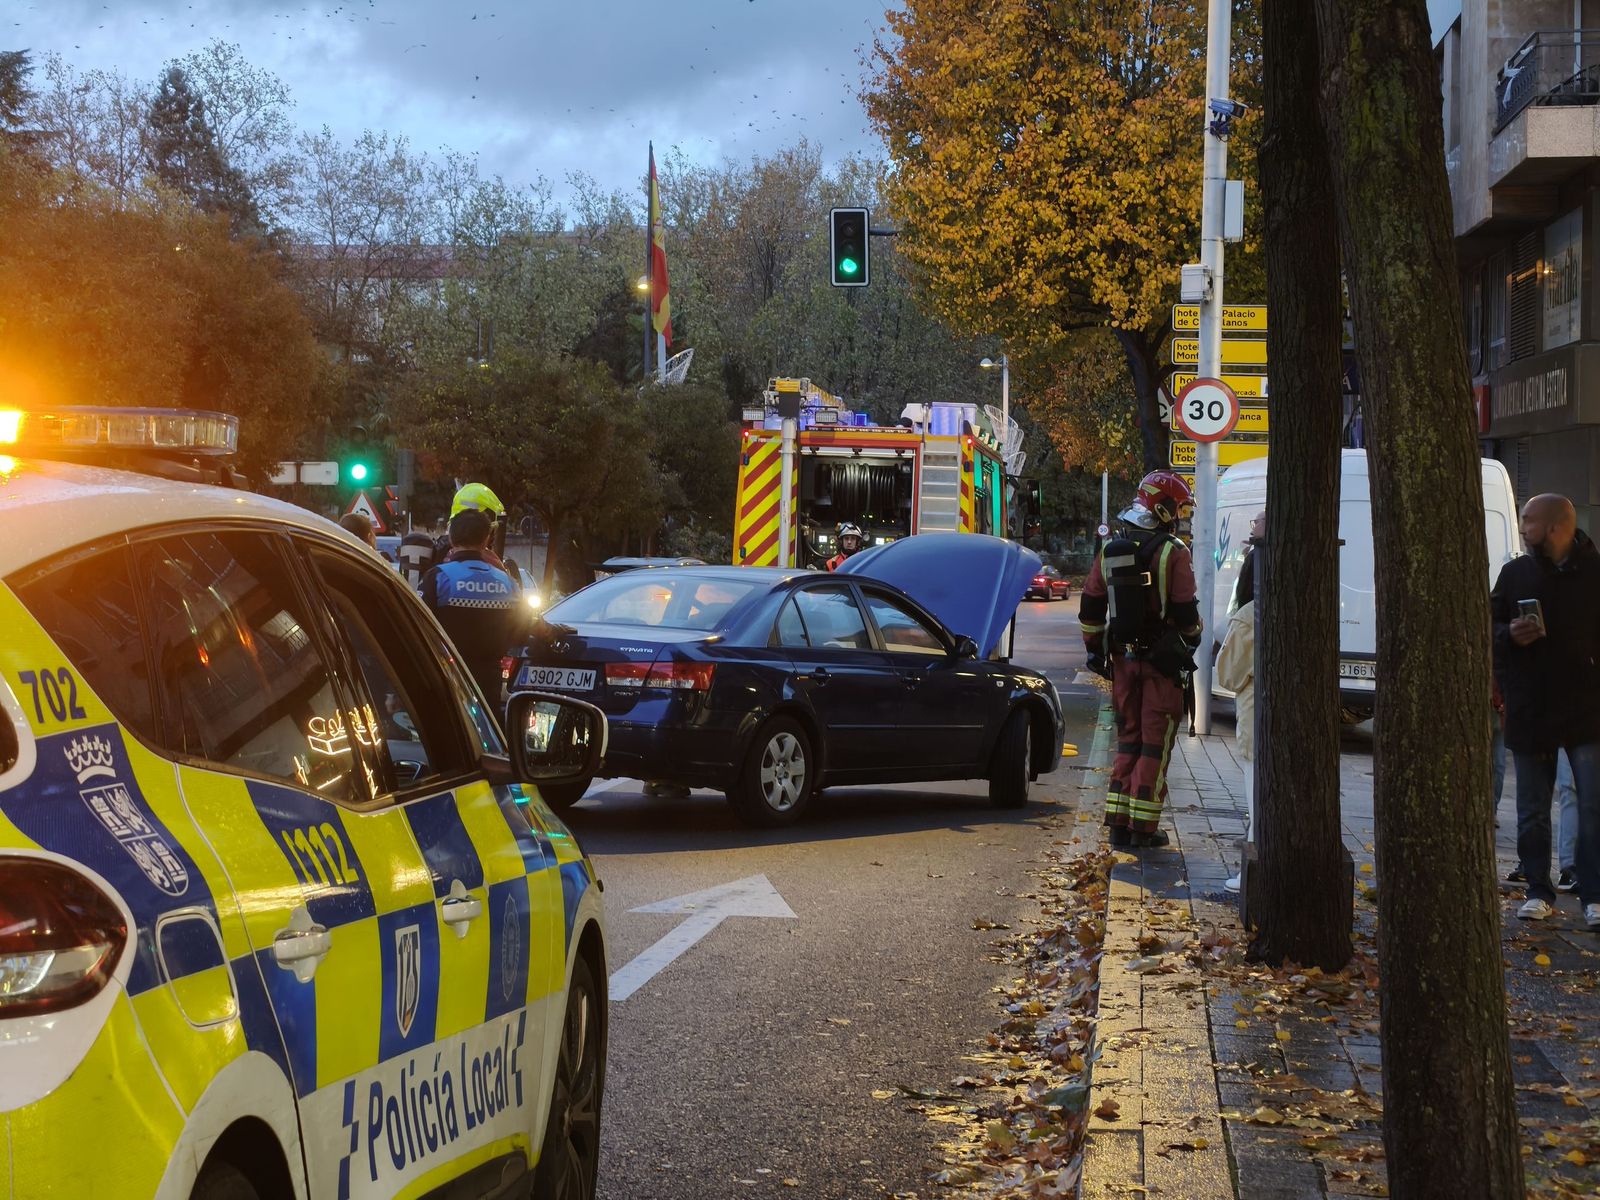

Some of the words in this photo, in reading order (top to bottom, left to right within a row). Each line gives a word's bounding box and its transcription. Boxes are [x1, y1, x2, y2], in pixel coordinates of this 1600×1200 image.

[1177, 309, 1199, 317] hote
[1222, 309, 1256, 318] Palacio
[1177, 318, 1189, 326] de
[1188, 399, 1225, 421] 30
[529, 668, 563, 686] 3902
[566, 671, 593, 689] GJM
[18, 666, 87, 724] 702
[367, 1051, 459, 1182] Policía
[461, 1023, 510, 1131] Local
